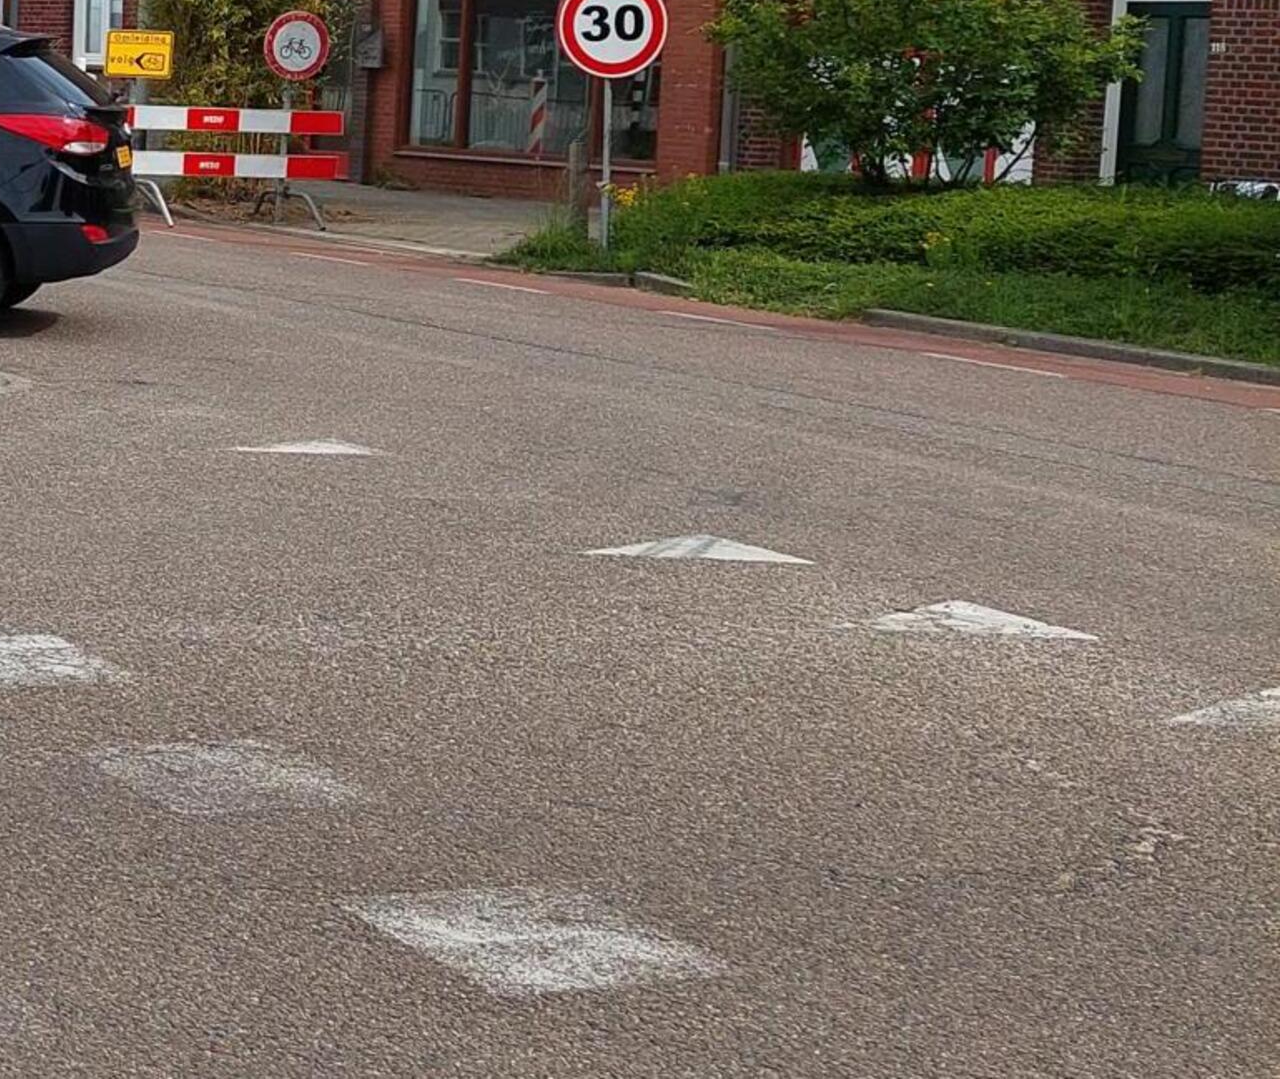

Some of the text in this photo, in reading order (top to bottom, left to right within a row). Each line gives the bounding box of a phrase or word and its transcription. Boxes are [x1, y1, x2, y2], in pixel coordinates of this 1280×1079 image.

[581, 4, 644, 42] 30
[114, 34, 166, 44] Omleiding
[111, 54, 134, 67] volg
